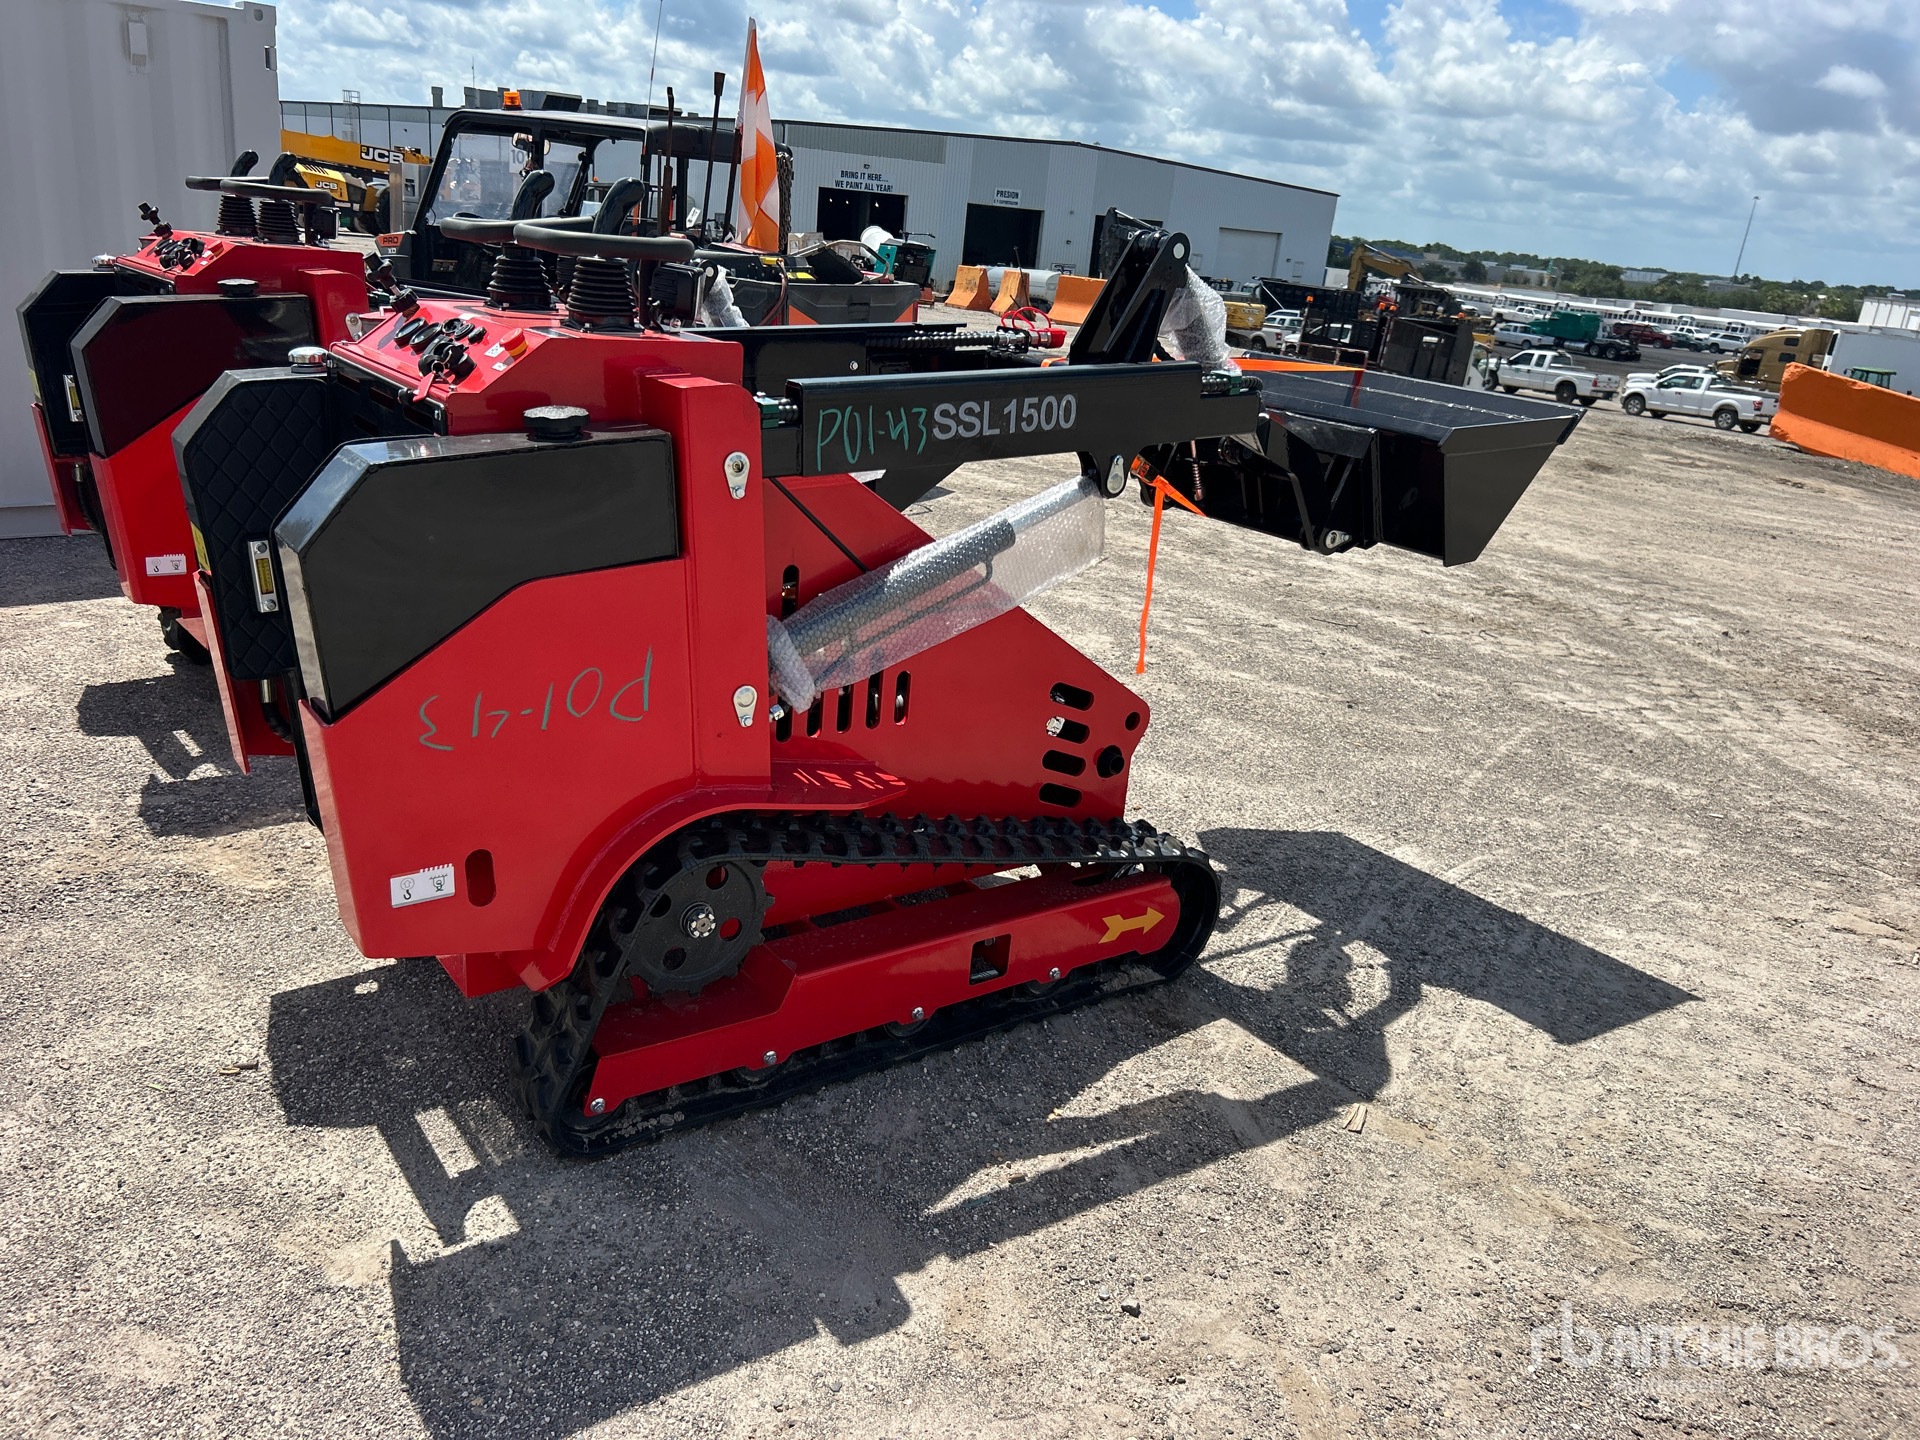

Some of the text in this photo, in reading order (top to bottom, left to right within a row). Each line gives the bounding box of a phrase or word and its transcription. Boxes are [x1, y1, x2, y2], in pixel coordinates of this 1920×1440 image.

[361, 146, 404, 164] JCB
[840, 170, 859, 180] BRING
[860, 172, 866, 180] IT
[315, 181, 338, 190] JCB
[834, 179, 845, 188] WE
[845, 181, 863, 190] PAINT
[864, 182, 875, 191] ALL
[382, 236, 399, 245] PRO
